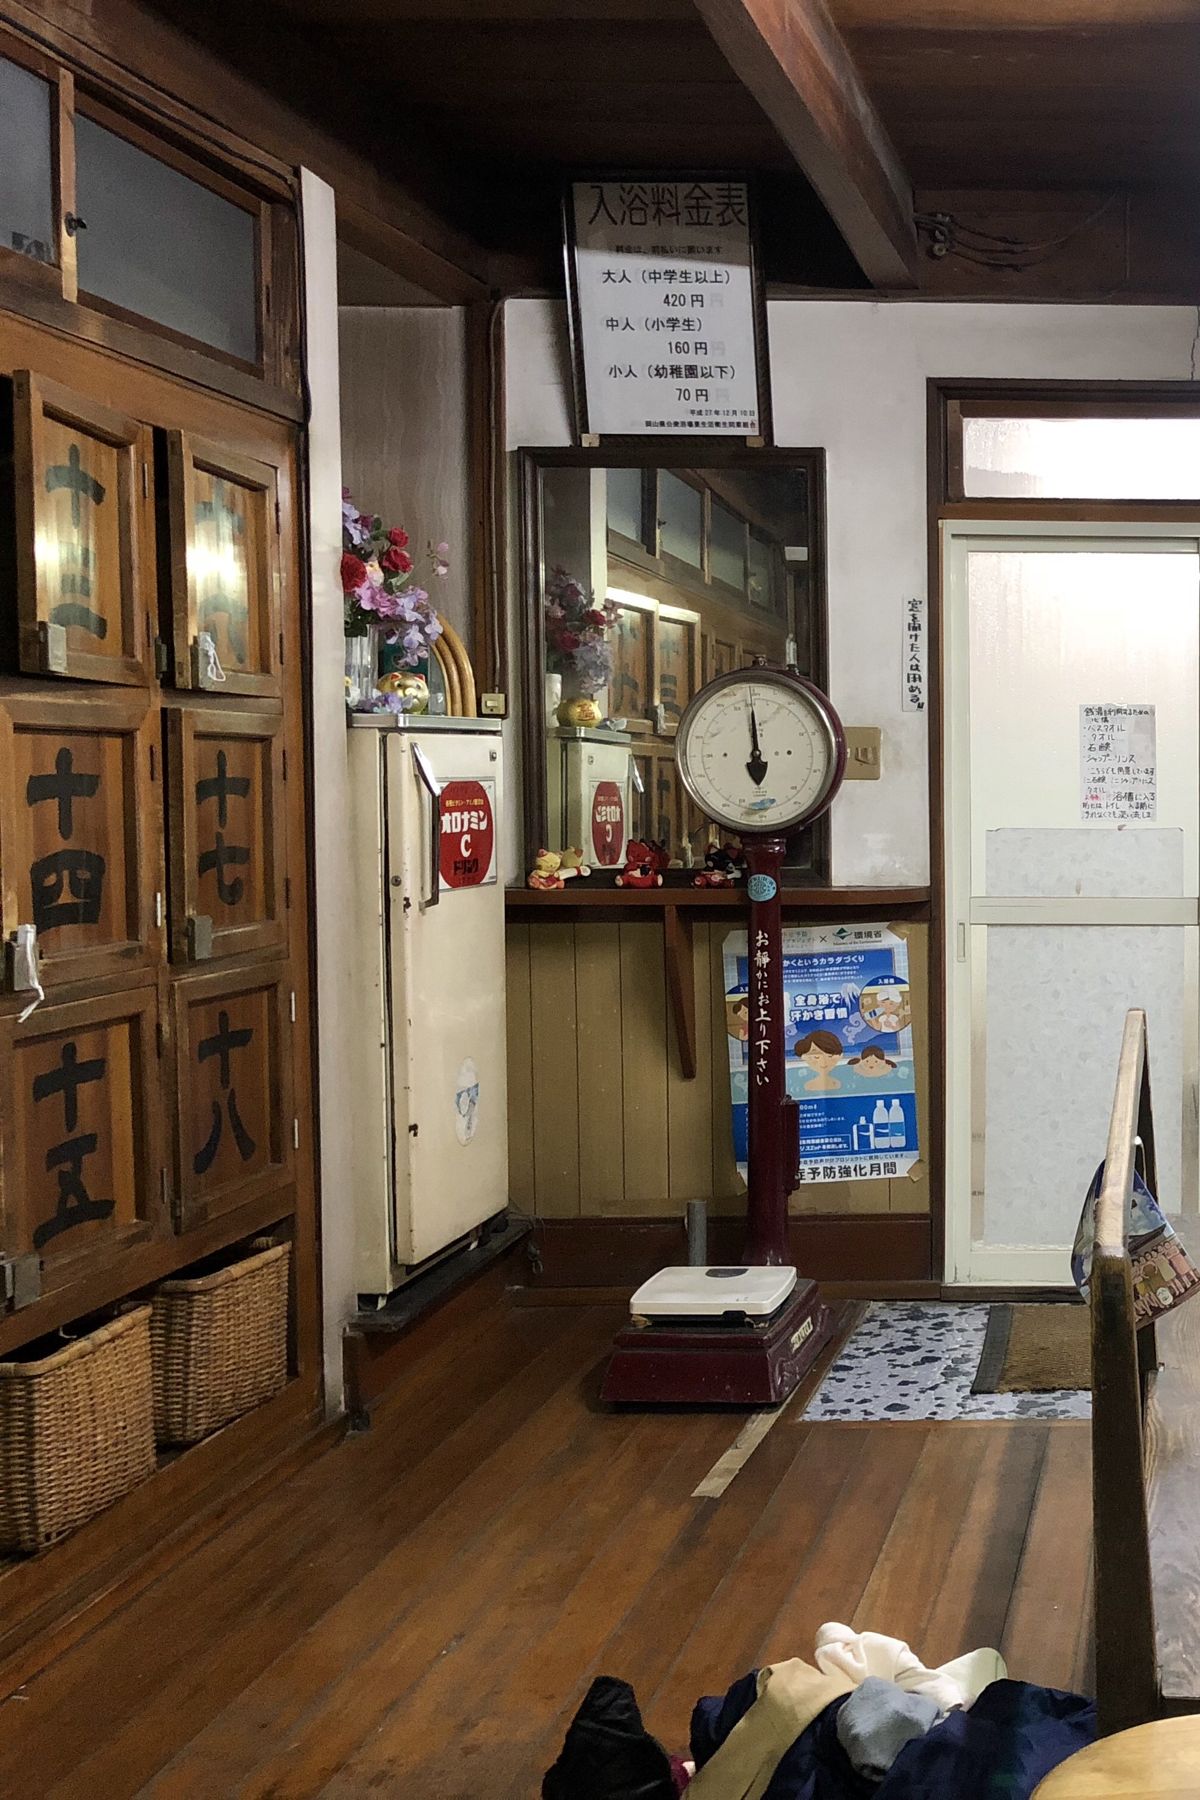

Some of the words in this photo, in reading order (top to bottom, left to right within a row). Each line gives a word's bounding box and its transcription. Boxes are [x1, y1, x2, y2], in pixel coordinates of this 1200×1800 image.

[588, 184, 747, 227] 入浴料金表
[195, 749, 251, 906] 十七
[441, 810, 487, 834] オロナミン
[27, 747, 106, 935] 十四
[460, 834, 472, 857] C
[453, 858, 479, 875] ドリンク
[854, 930, 882, 939] 環境省
[753, 930, 772, 1086] お静かにお上り下さい
[790, 1008, 848, 1022] 汗かき習慣
[794, 993, 841, 1007] 全身浴で
[194, 1010, 256, 1174] 十八
[33, 1041, 115, 1249] 十五
